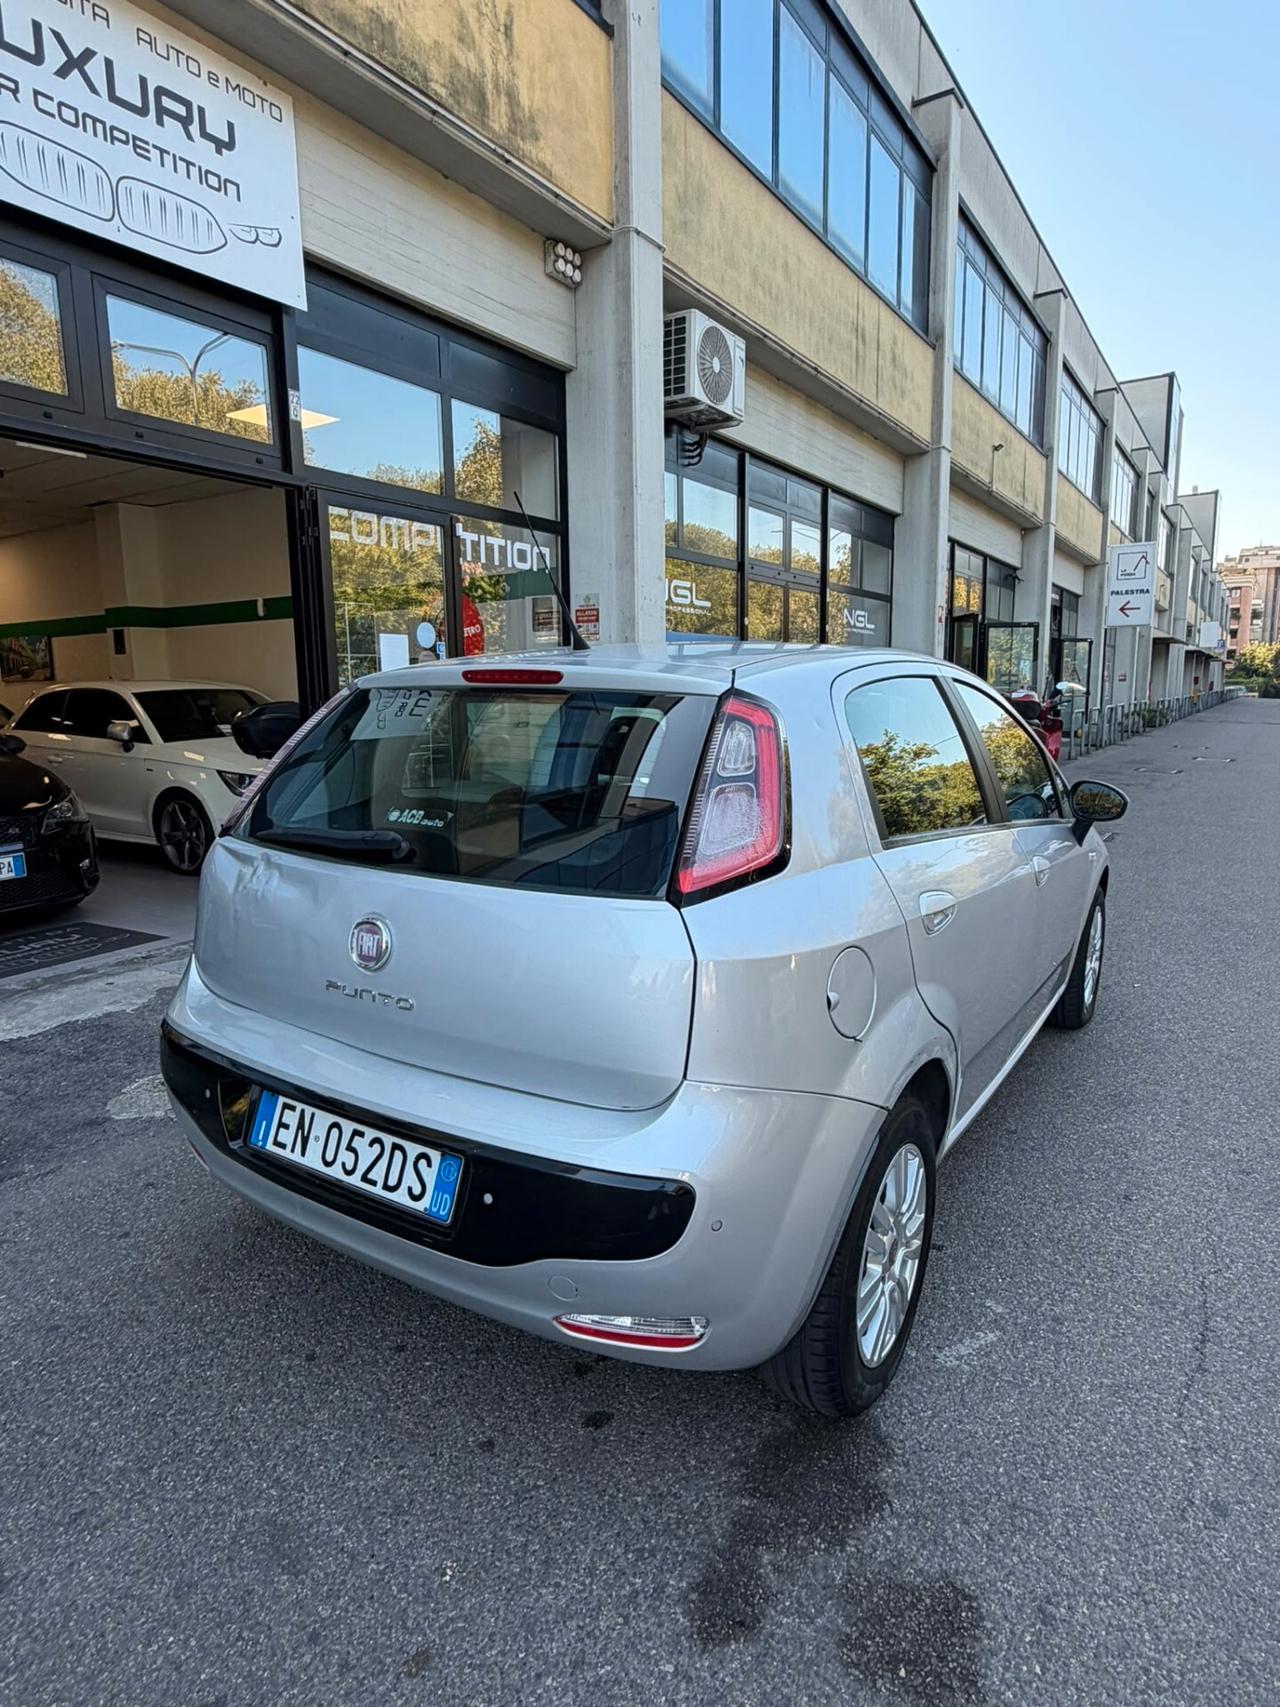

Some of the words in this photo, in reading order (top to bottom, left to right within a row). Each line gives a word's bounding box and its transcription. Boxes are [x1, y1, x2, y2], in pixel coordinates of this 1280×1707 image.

[0, 4, 236, 156] UXURY
[136, 27, 201, 78] AUTO
[225, 76, 283, 123] MOTO
[32, 88, 242, 202] COMPETITION
[328, 505, 550, 574] COMPTITION
[1110, 588, 1150, 596] PALESTRA
[843, 608, 875, 628] NGL
[357, 931, 380, 957] FIAT
[325, 979, 415, 1011] PUNTO
[431, 1189, 450, 1216] UD
